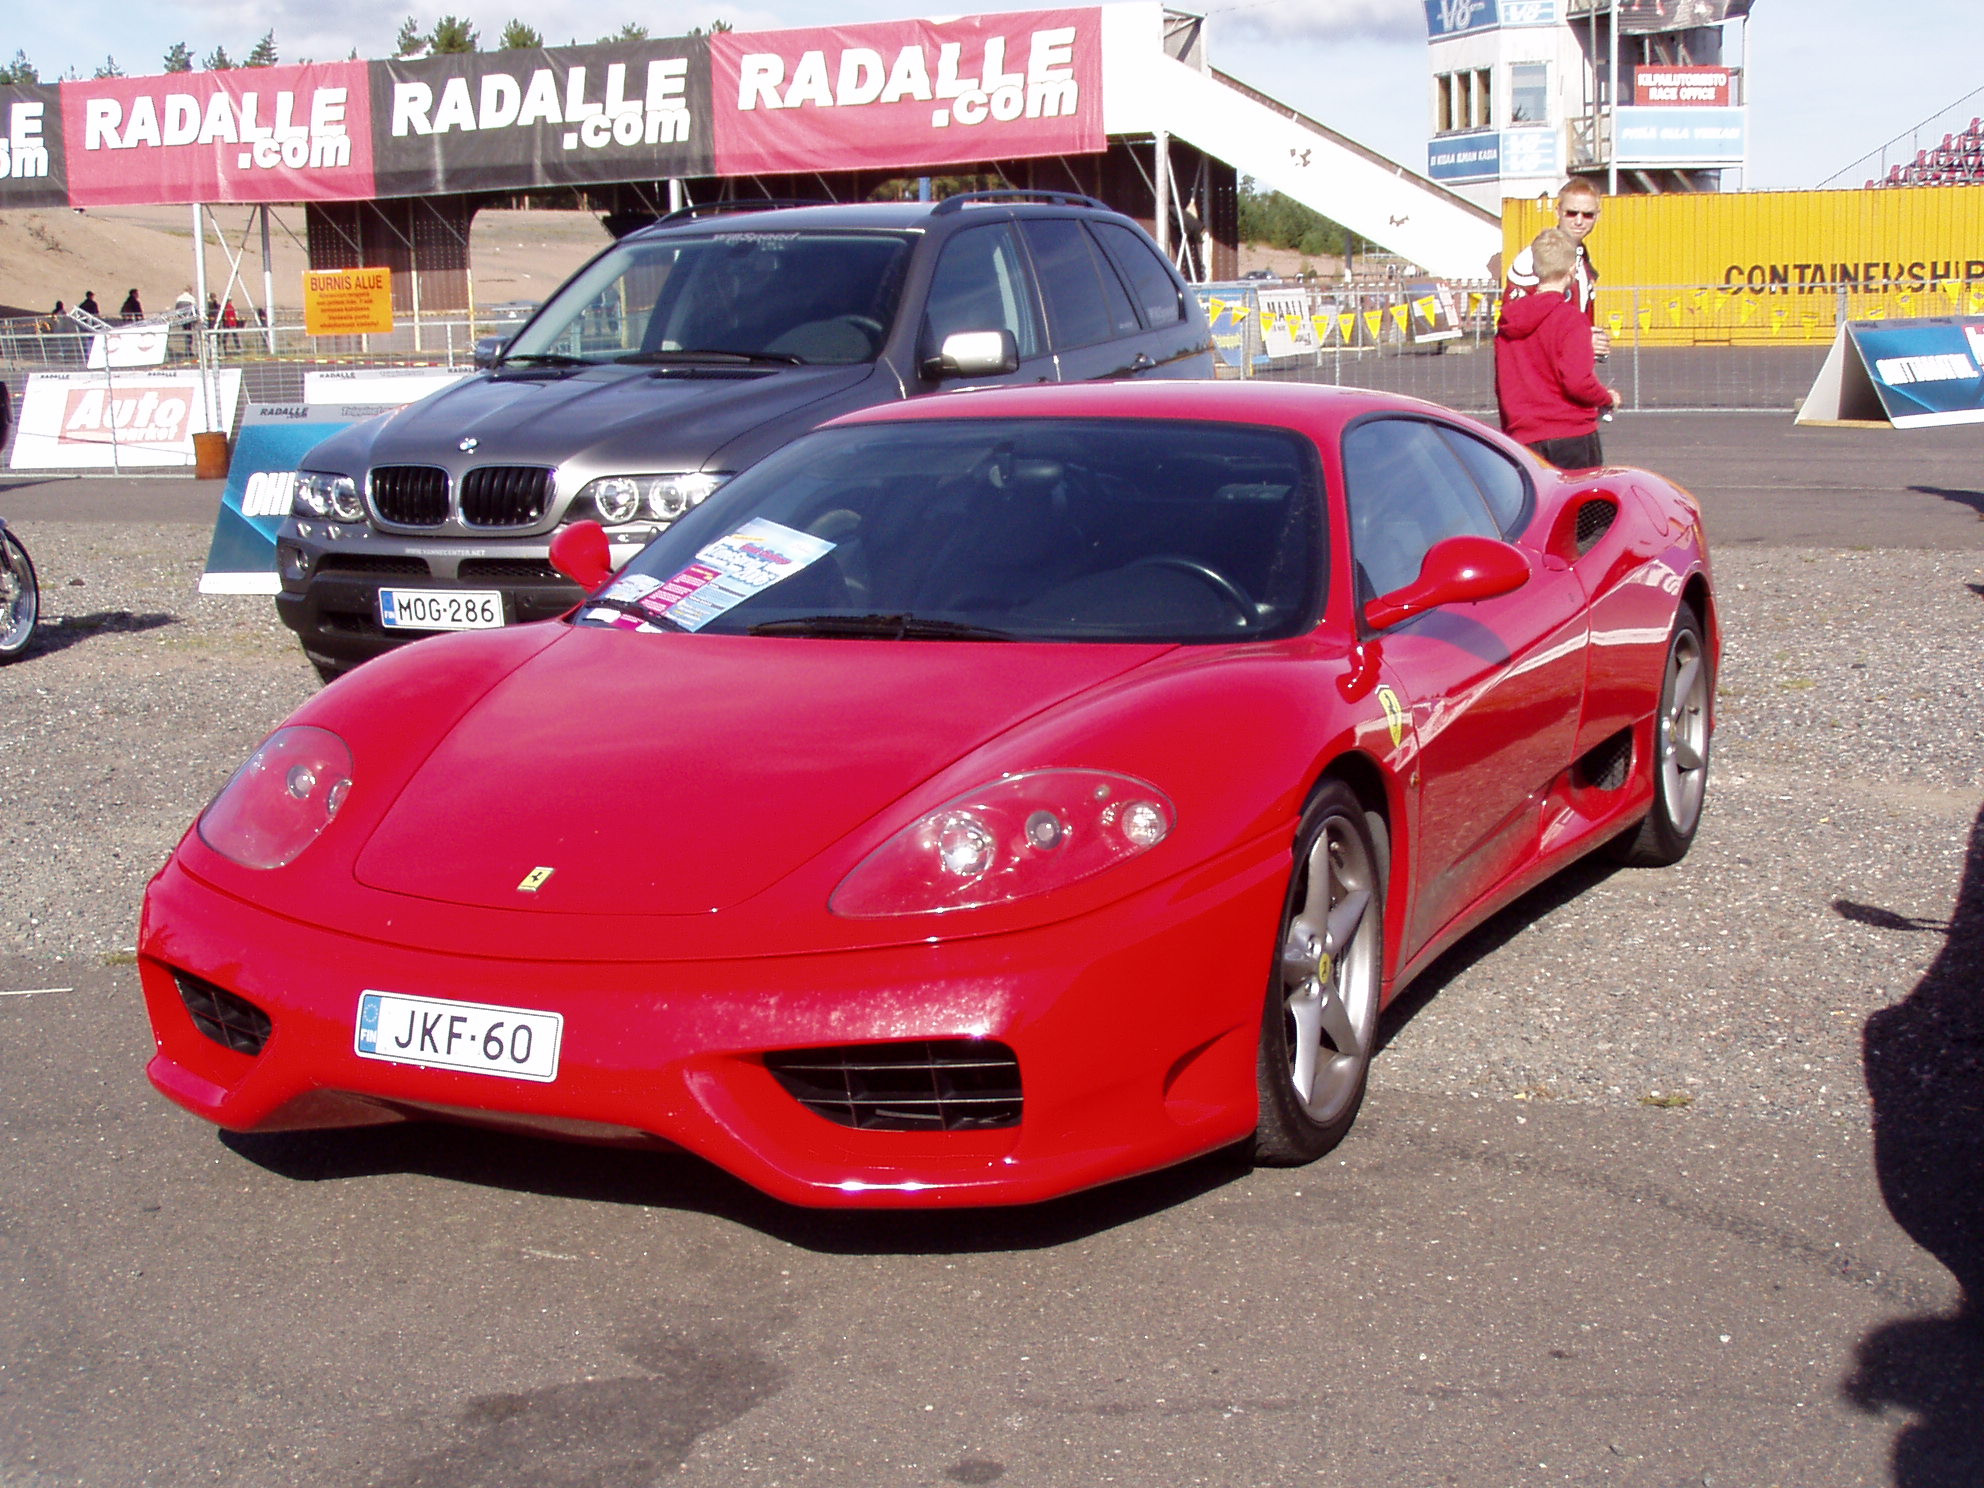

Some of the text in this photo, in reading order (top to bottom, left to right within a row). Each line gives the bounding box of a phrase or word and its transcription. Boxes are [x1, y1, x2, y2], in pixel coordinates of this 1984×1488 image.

[737, 26, 1077, 110] RADALLE
[391, 57, 688, 137] RADALLE
[931, 78, 1079, 127] .com
[1648, 87, 1716, 100] RACE OFFICE
[0, 102, 44, 149] E
[85, 87, 348, 150] RADALLE
[562, 107, 691, 150] .com
[237, 134, 351, 169] .com
[310, 274, 383, 291] BURNIS ALUE
[65, 388, 187, 431] Auto
[260, 407, 309, 417] RADALLE
[397, 597, 494, 623] MOG-286
[360, 1028, 378, 1044] FIN
[394, 1010, 533, 1064] JKF-60
